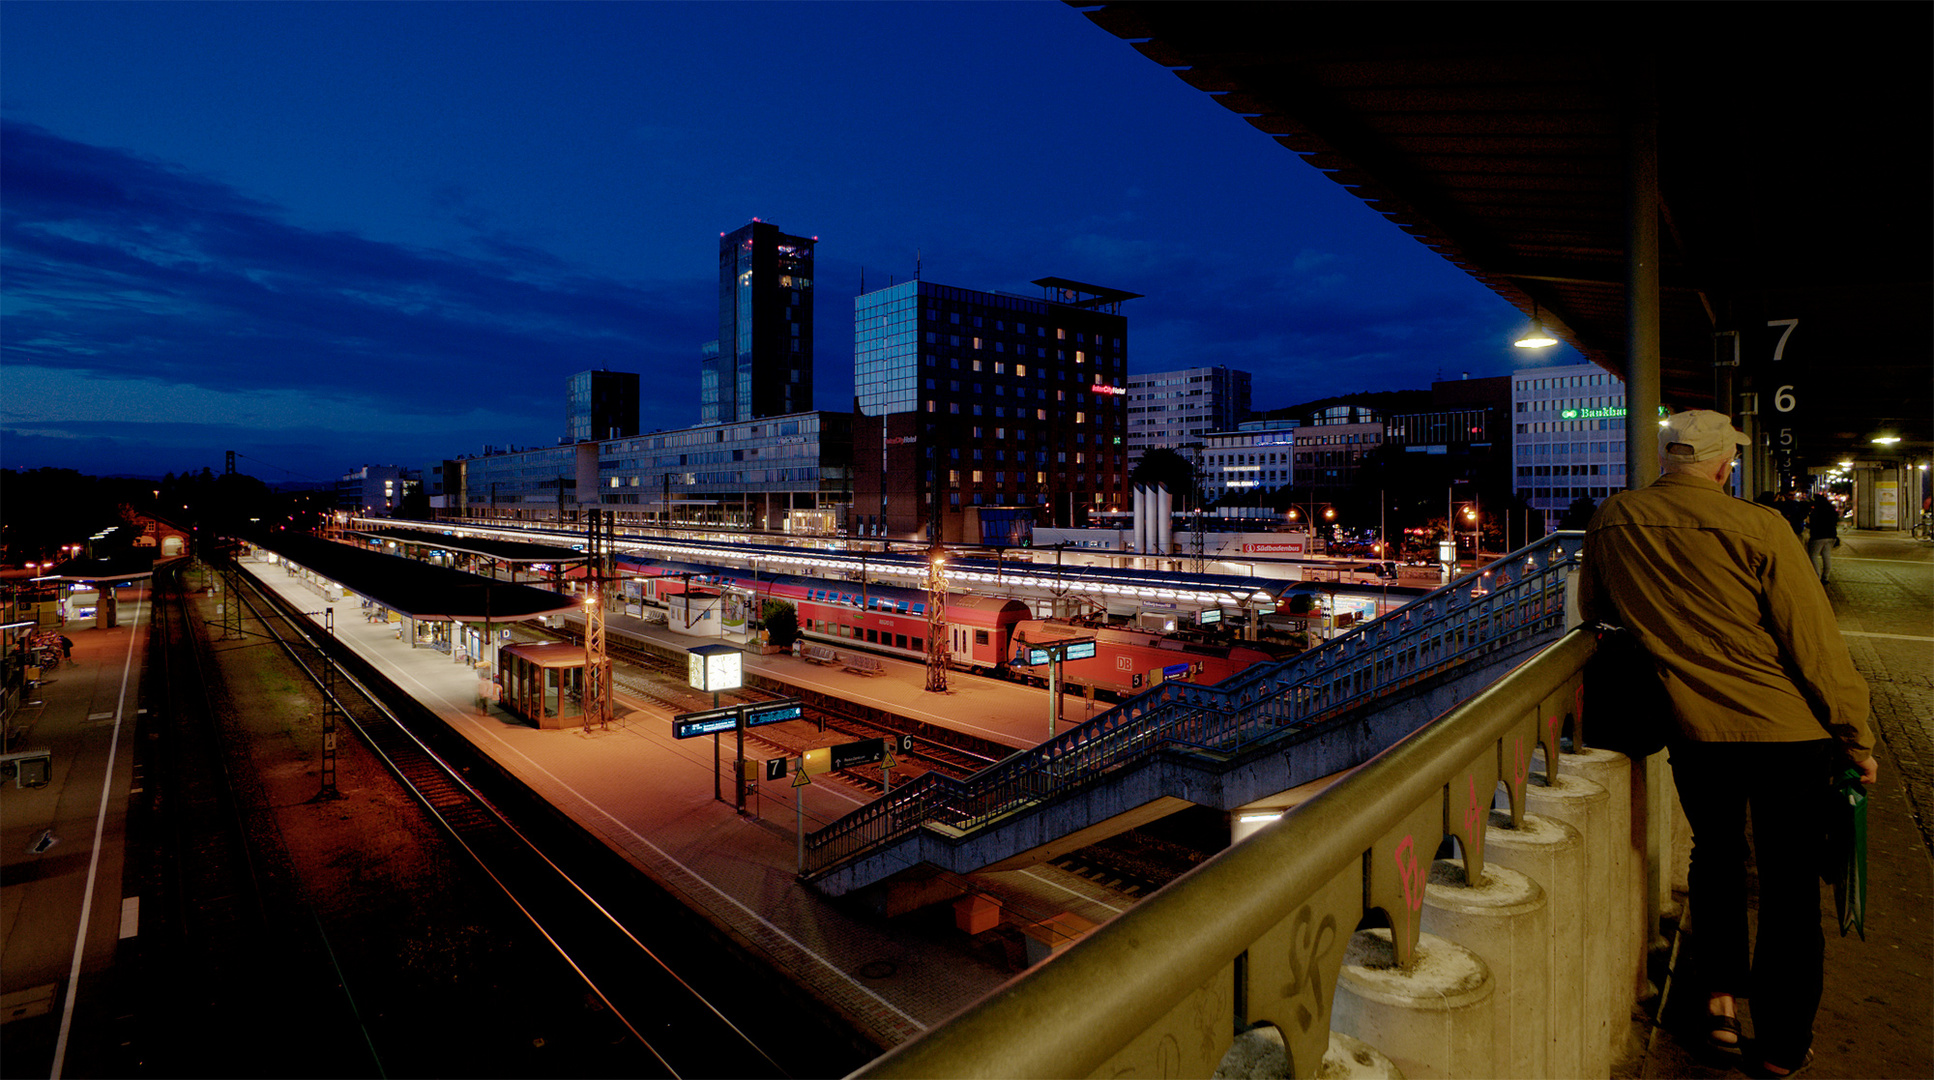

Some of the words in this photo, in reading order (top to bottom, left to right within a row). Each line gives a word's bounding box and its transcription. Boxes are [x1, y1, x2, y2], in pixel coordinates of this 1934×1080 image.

[1767, 318, 1799, 361] 7
[1774, 384, 1796, 413] 6
[1779, 428, 1793, 446] 5
[503, 629, 511, 638] D
[1118, 657, 1132, 670] DB
[1198, 661, 1204, 673] 4
[1134, 674, 1140, 686] 5
[903, 735, 912, 750] 6
[770, 759, 780, 776] 7
